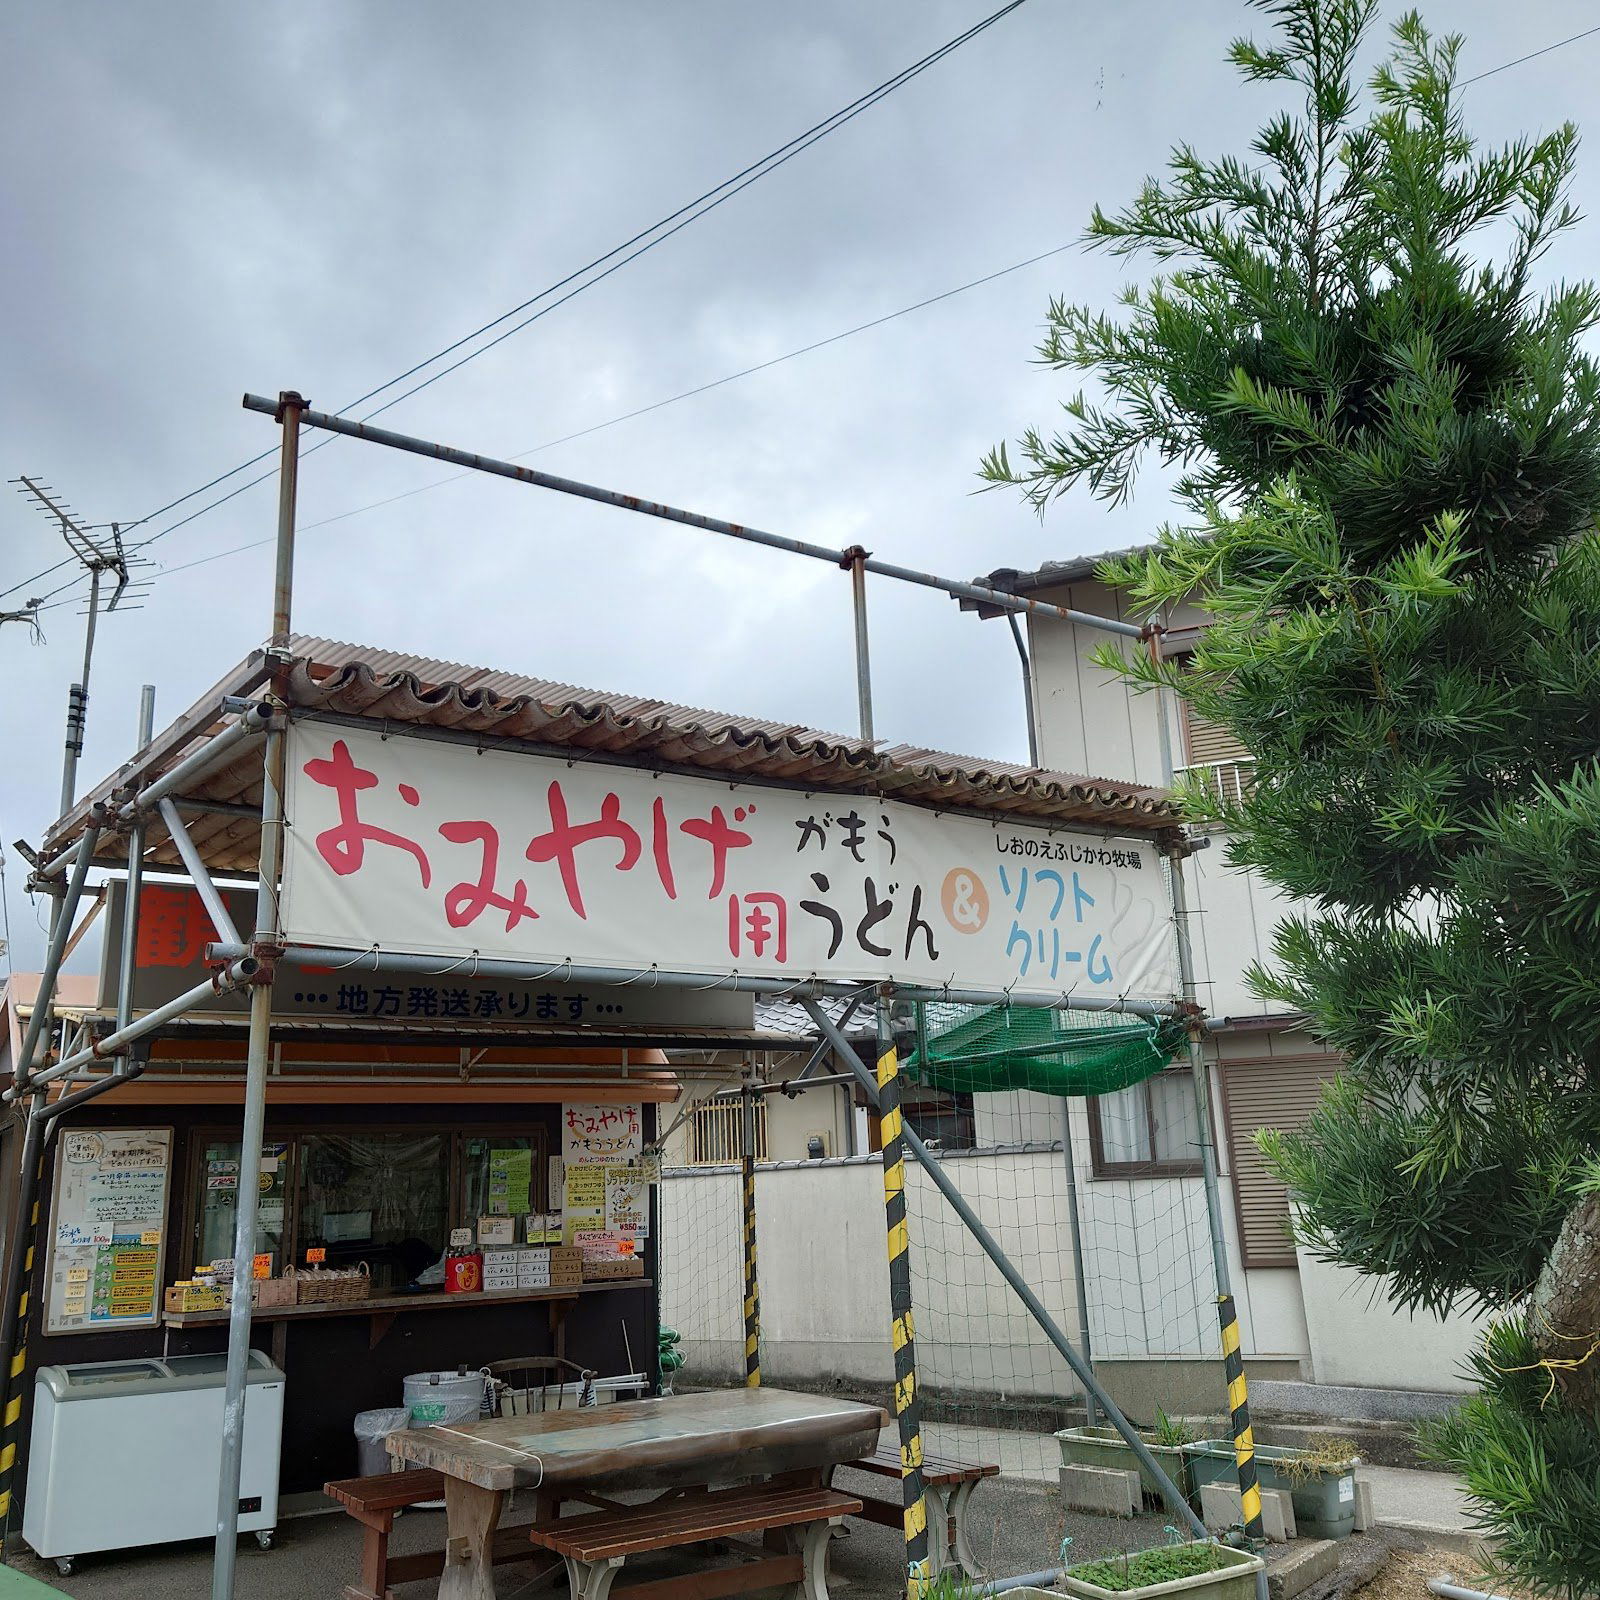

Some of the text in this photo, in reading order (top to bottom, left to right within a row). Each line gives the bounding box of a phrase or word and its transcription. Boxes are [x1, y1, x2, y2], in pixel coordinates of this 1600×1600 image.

[796, 810, 896, 865] がもう
[996, 834, 1142, 870] しおのえふじかわ牧場
[800, 872, 939, 961] うどん
[999, 864, 1095, 922] ソフト
[1006, 920, 1113, 984] クリーム
